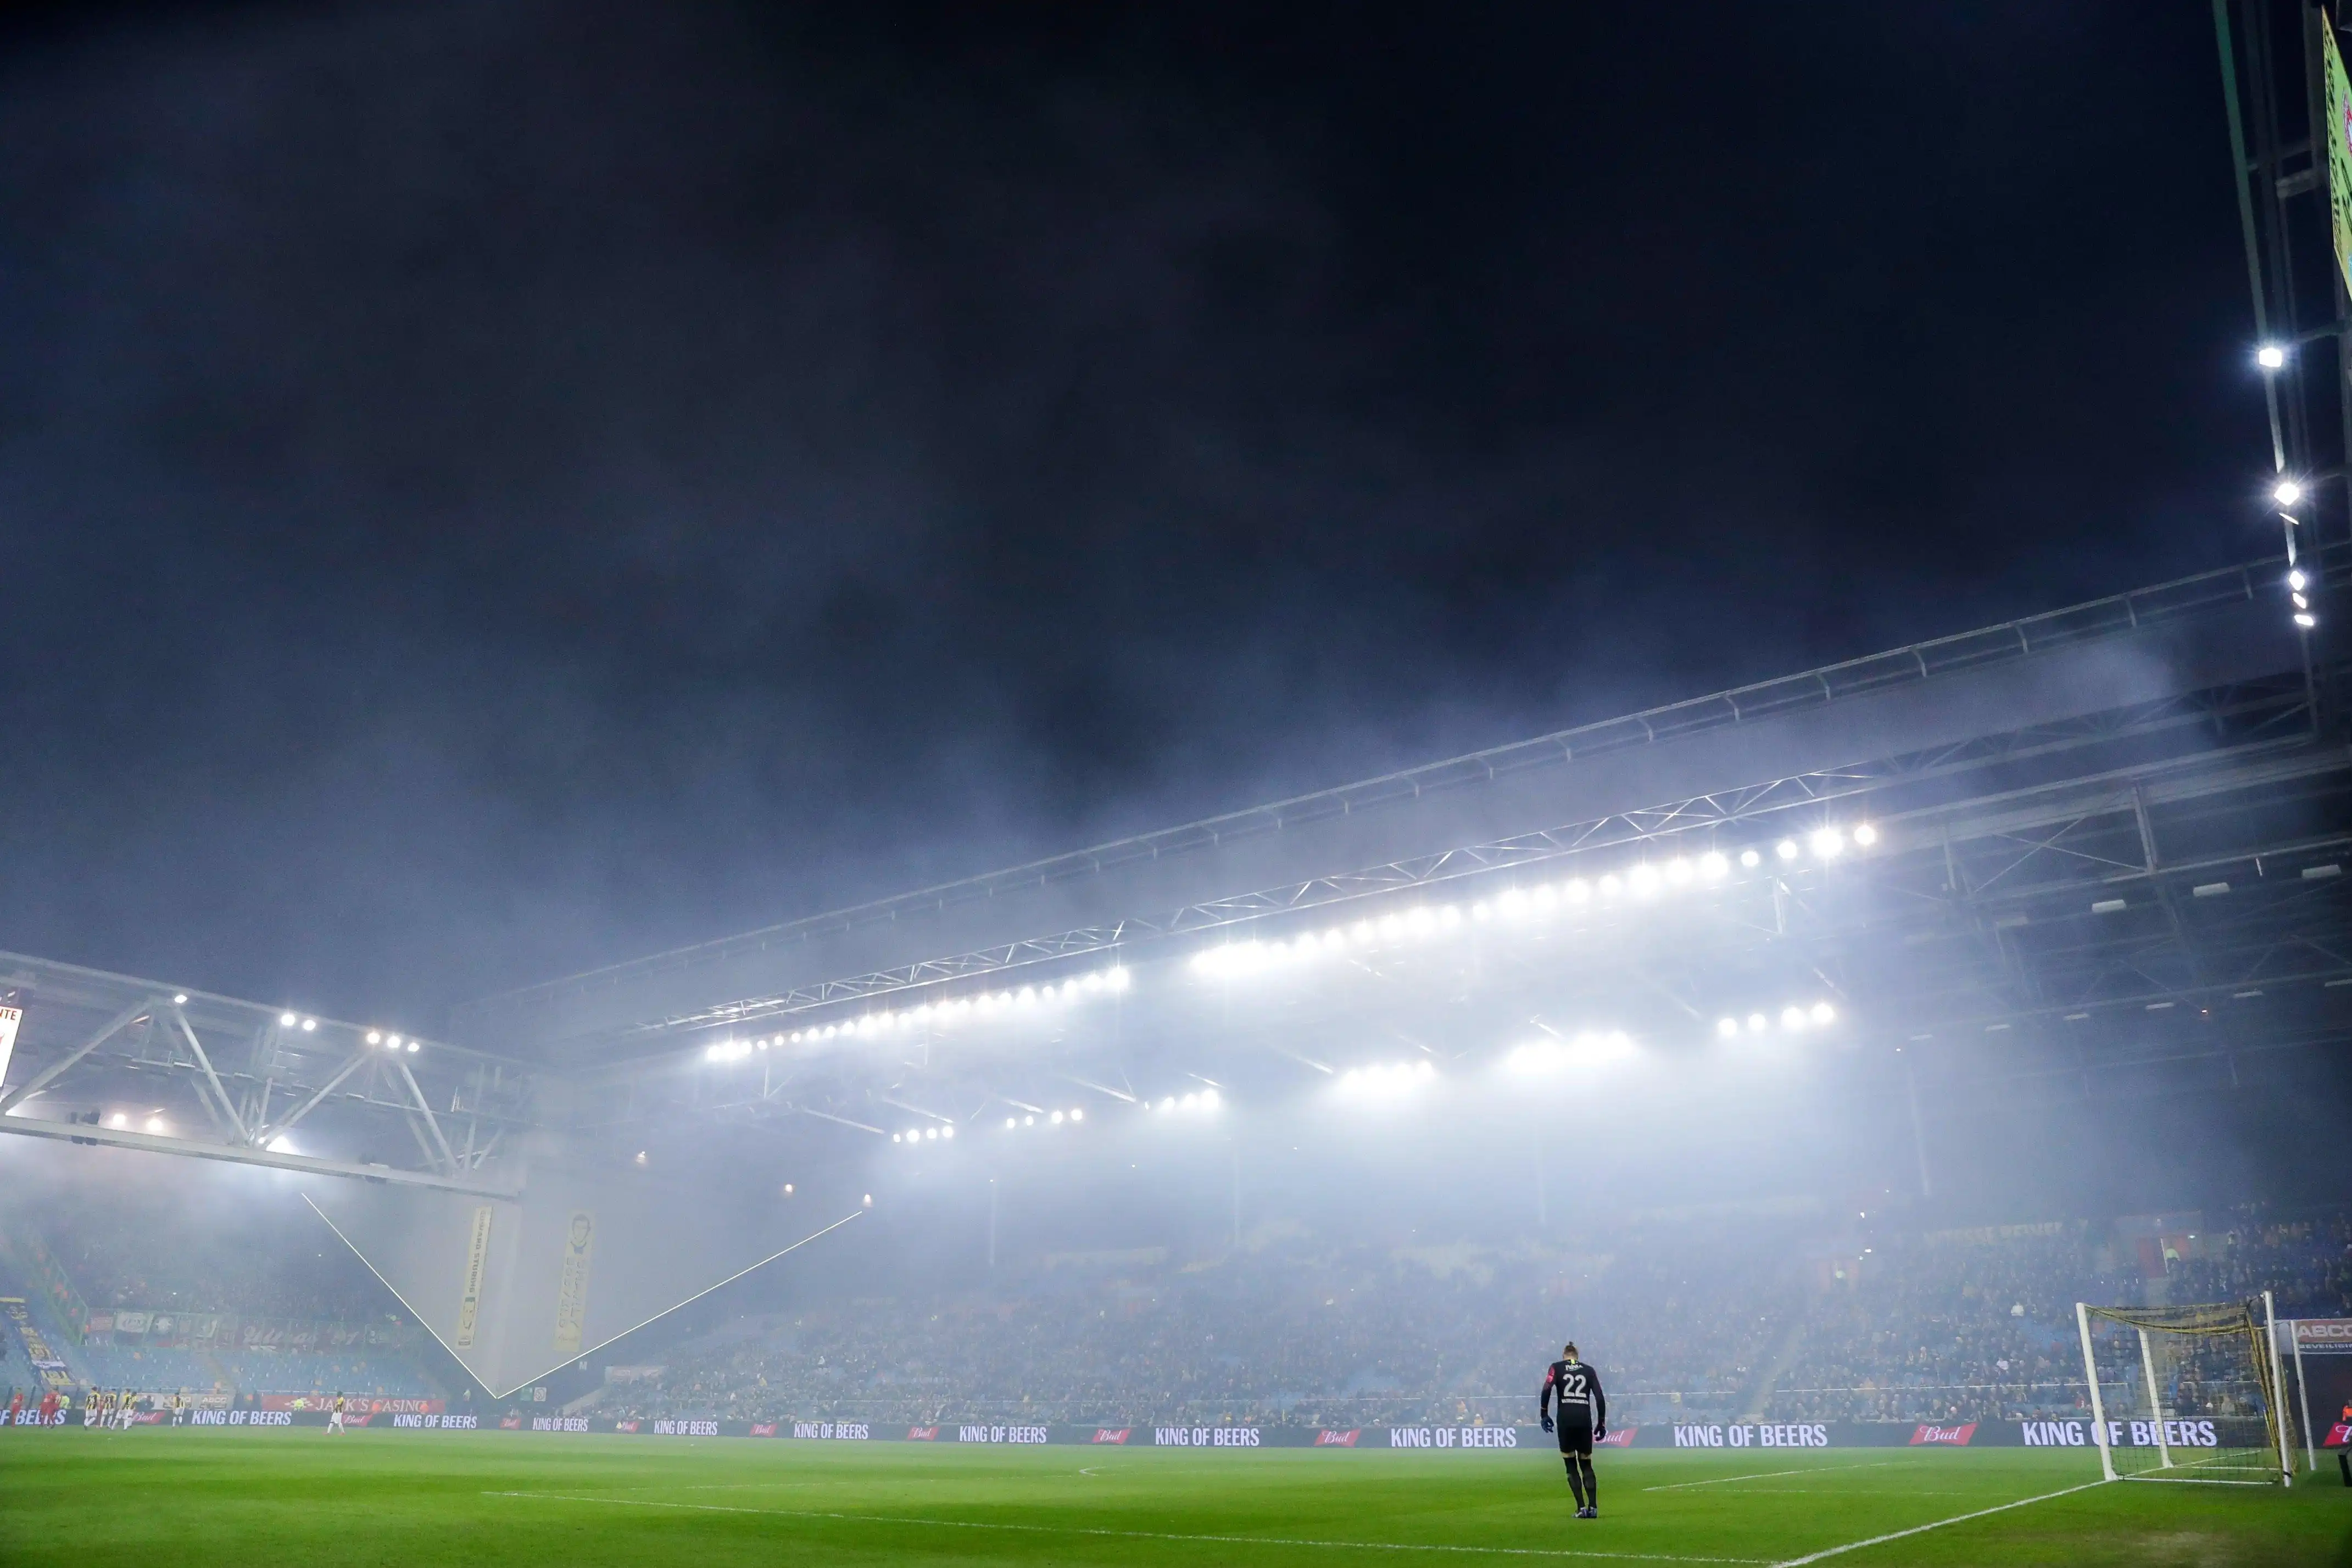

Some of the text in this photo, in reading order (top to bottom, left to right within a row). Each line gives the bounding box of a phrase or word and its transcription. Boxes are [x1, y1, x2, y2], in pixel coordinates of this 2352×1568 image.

[469, 1253, 480, 1293] STURING
[1563, 1374, 1587, 1398] 22
[316, 1398, 369, 1411] JAK'S
[0, 1409, 11, 1425] F
[192, 1410, 292, 1425] KING OF BEERS
[343, 1414, 365, 1424] Bud
[394, 1414, 477, 1429] KING OF BEERS
[533, 1417, 588, 1432] KING OF BEERS
[654, 1420, 718, 1435] KING OF BEERS
[754, 1424, 771, 1435] Bud
[794, 1423, 868, 1439] KING OF BEERS
[911, 1427, 932, 1438] Bud
[960, 1426, 1047, 1443] KING OF BEERS
[1099, 1429, 1121, 1441] Bud
[1920, 1426, 1960, 1442] Bud
[2022, 1421, 2085, 1446] KING
[1155, 1427, 1259, 1446] KING OF BEERS
[1322, 1431, 1350, 1444] Bud
[1391, 1427, 1517, 1448] KING OF BEERS
[1674, 1424, 1827, 1447] KING OF BEERS
